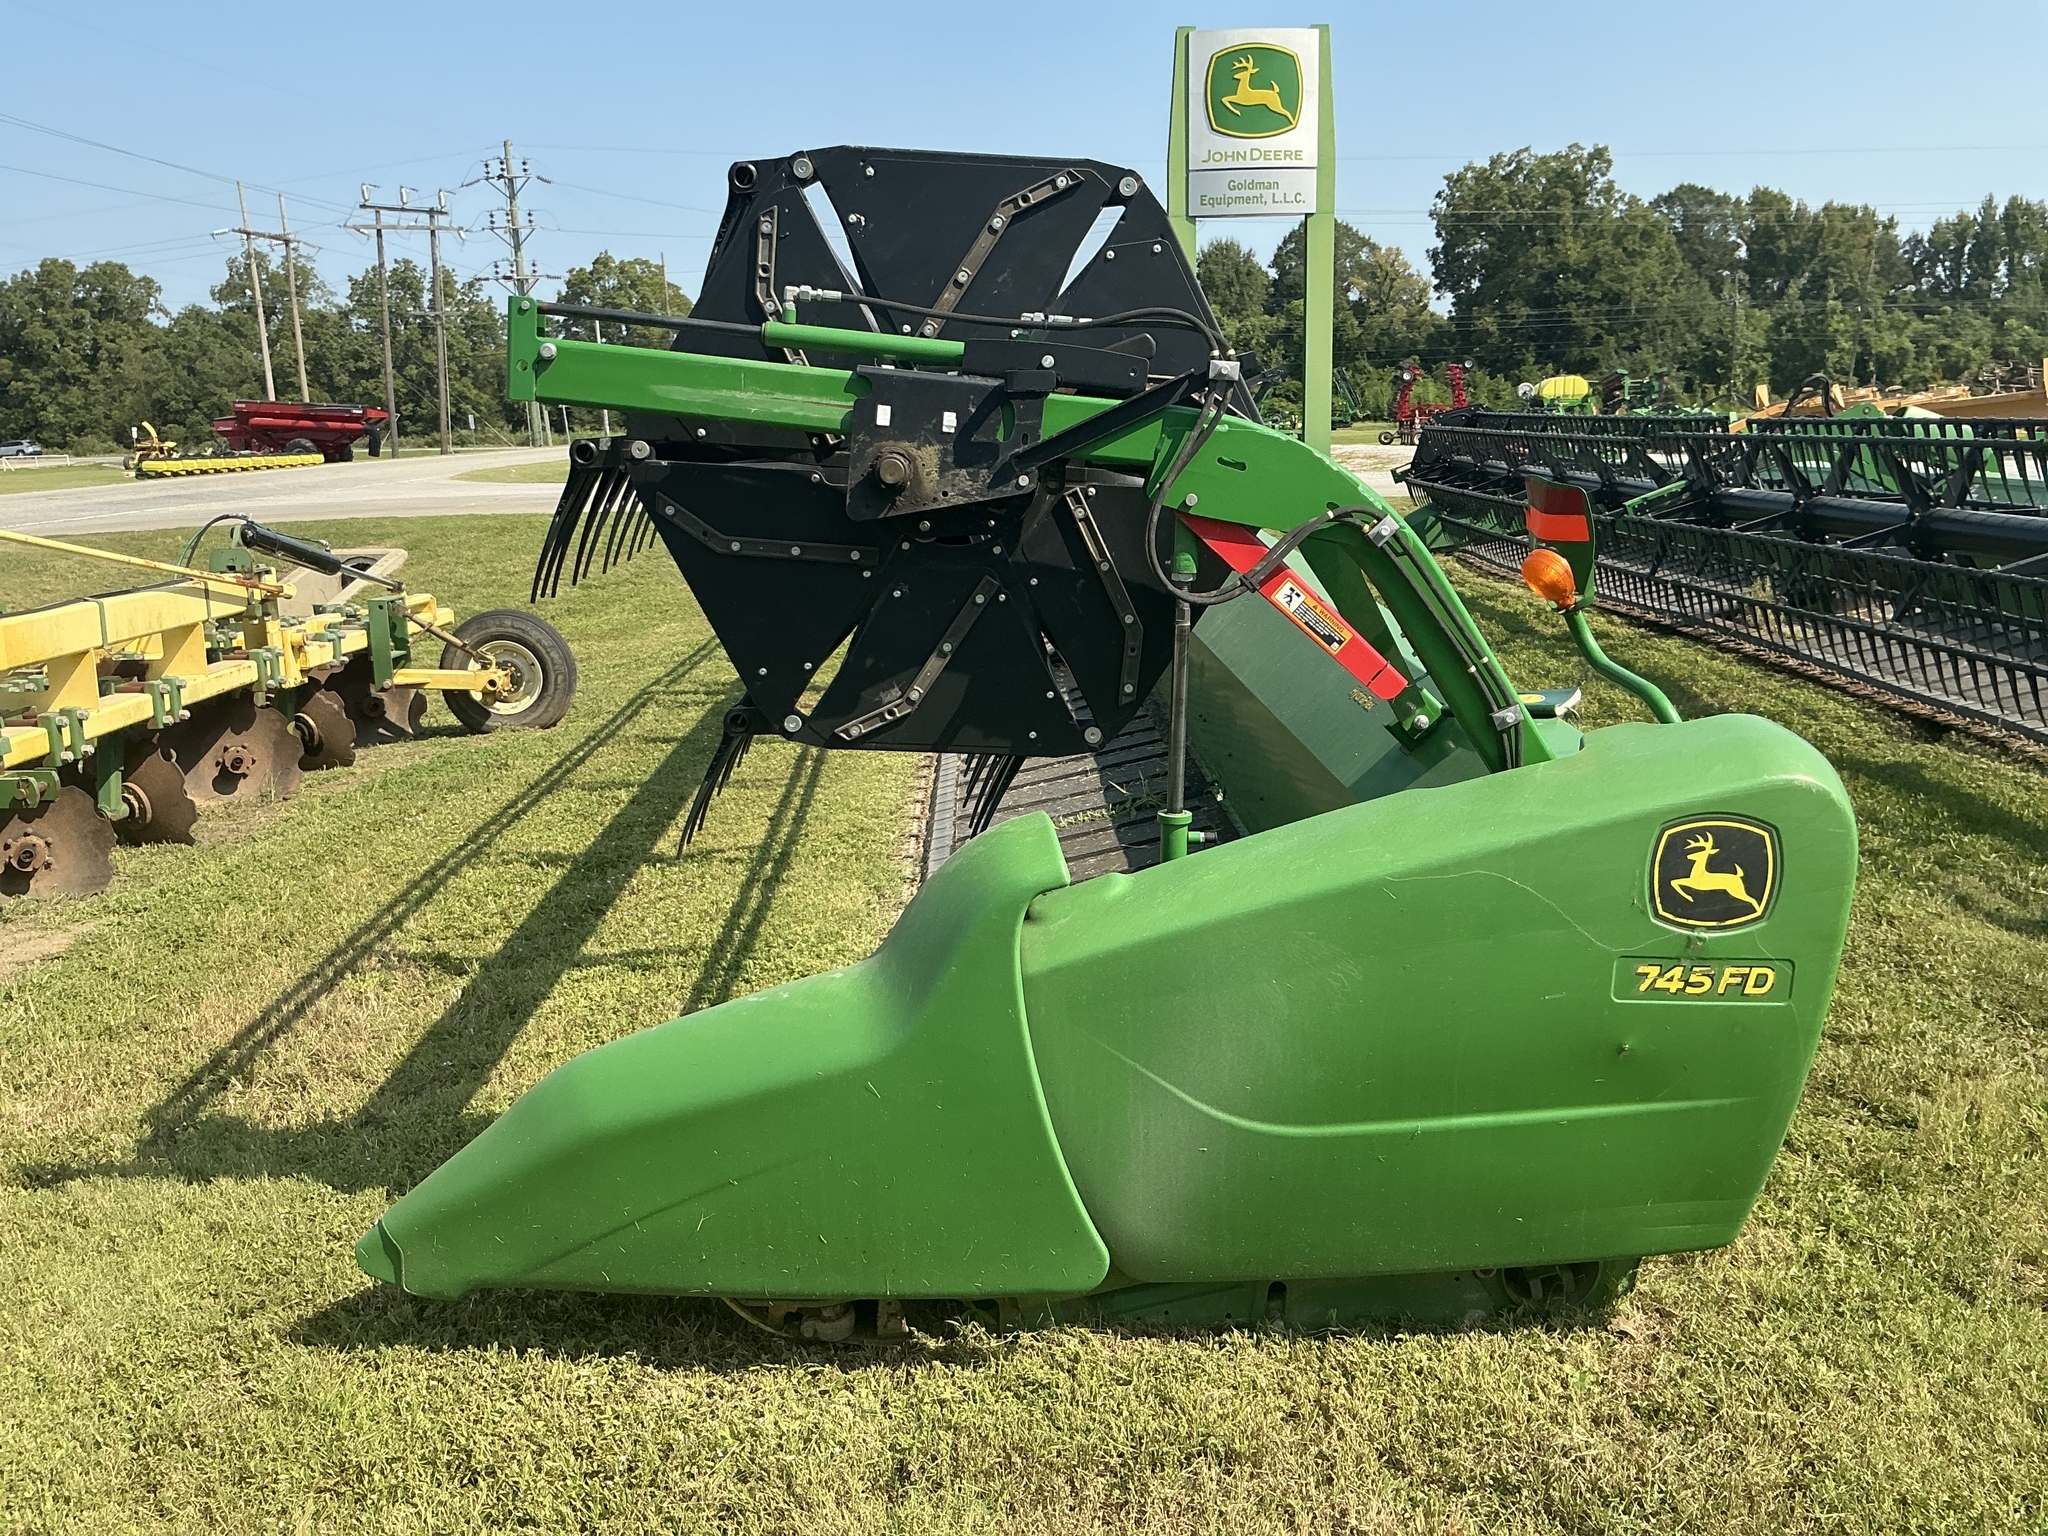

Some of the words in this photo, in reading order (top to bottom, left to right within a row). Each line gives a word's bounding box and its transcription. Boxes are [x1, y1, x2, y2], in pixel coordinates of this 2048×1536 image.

[1201, 149, 1247, 163] JOHN
[1250, 147, 1304, 161] DEERE
[1227, 179, 1279, 191] Goldman
[1200, 193, 1267, 208] Equipment,
[1272, 192, 1306, 204] L.L.C.
[1319, 608, 1345, 634] WARNING
[1635, 964, 1716, 996] 745
[1717, 965, 1776, 996] FD
